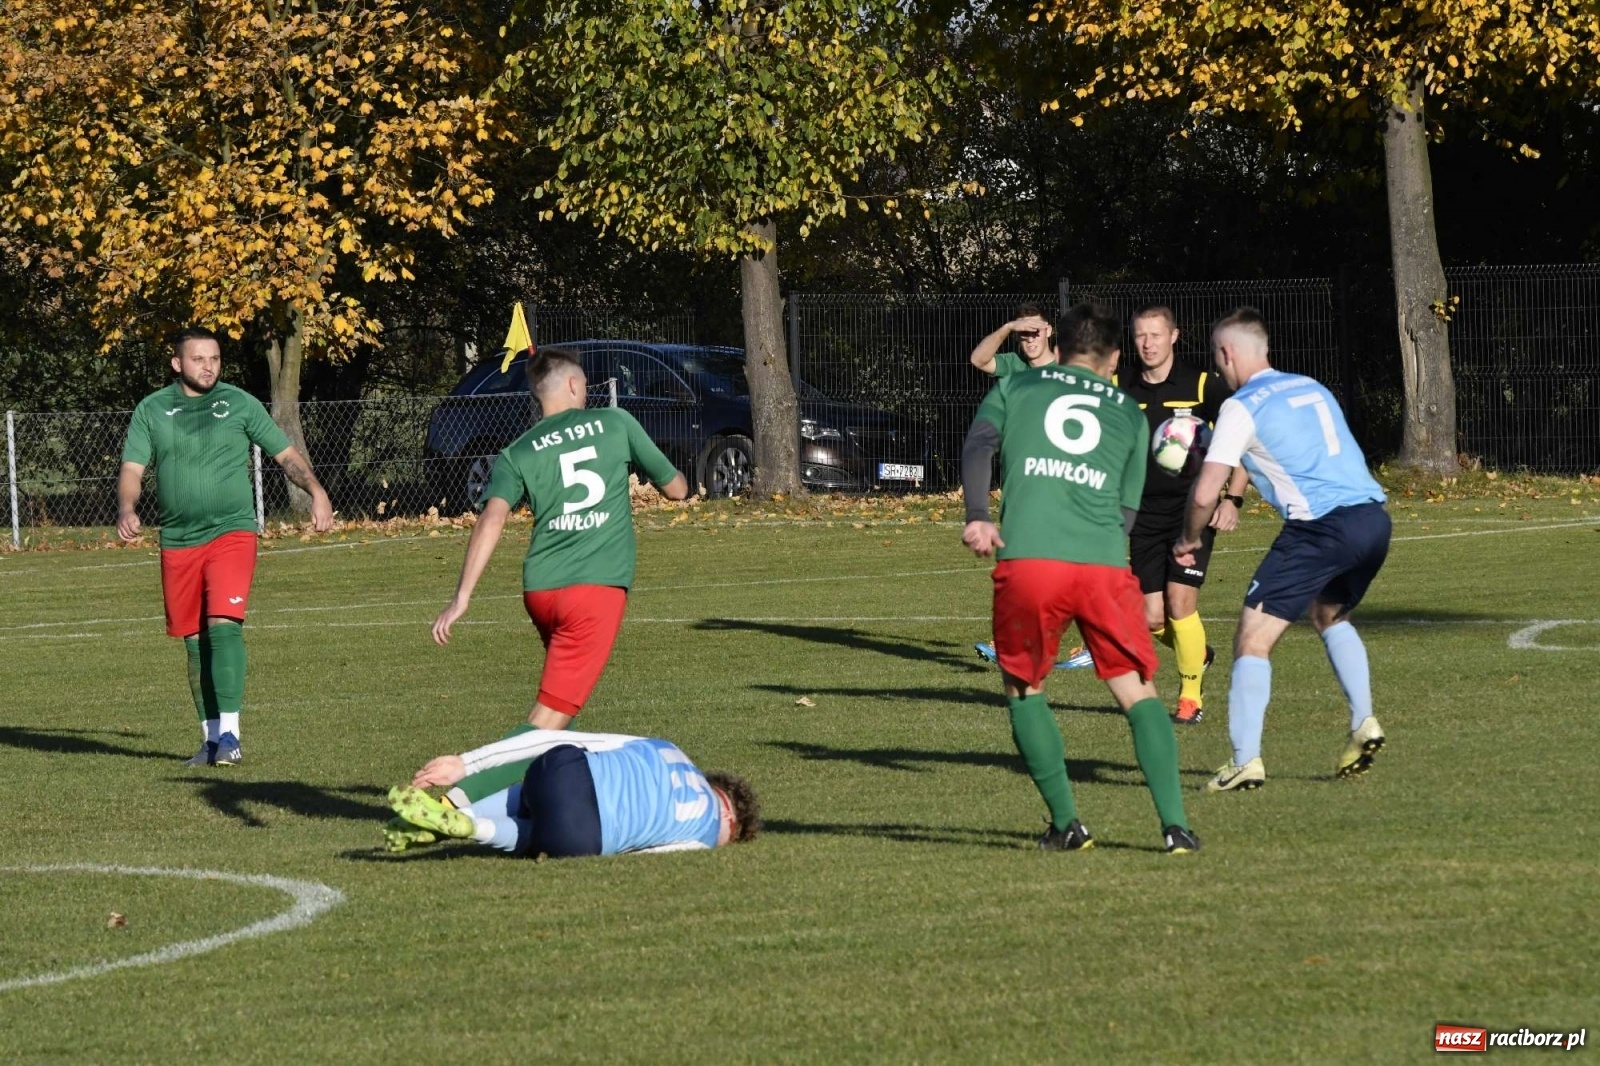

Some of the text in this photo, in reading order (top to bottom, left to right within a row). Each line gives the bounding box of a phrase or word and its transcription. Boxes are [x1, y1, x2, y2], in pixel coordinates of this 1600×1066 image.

[1041, 369, 1125, 404] LKS 1911
[531, 419, 605, 452] LKS 1911
[1043, 393, 1102, 455] 6
[1286, 391, 1341, 457] 7
[559, 445, 606, 515] 5
[1024, 456, 1107, 491] PAWŁÓW
[1247, 579, 1260, 596] 7
